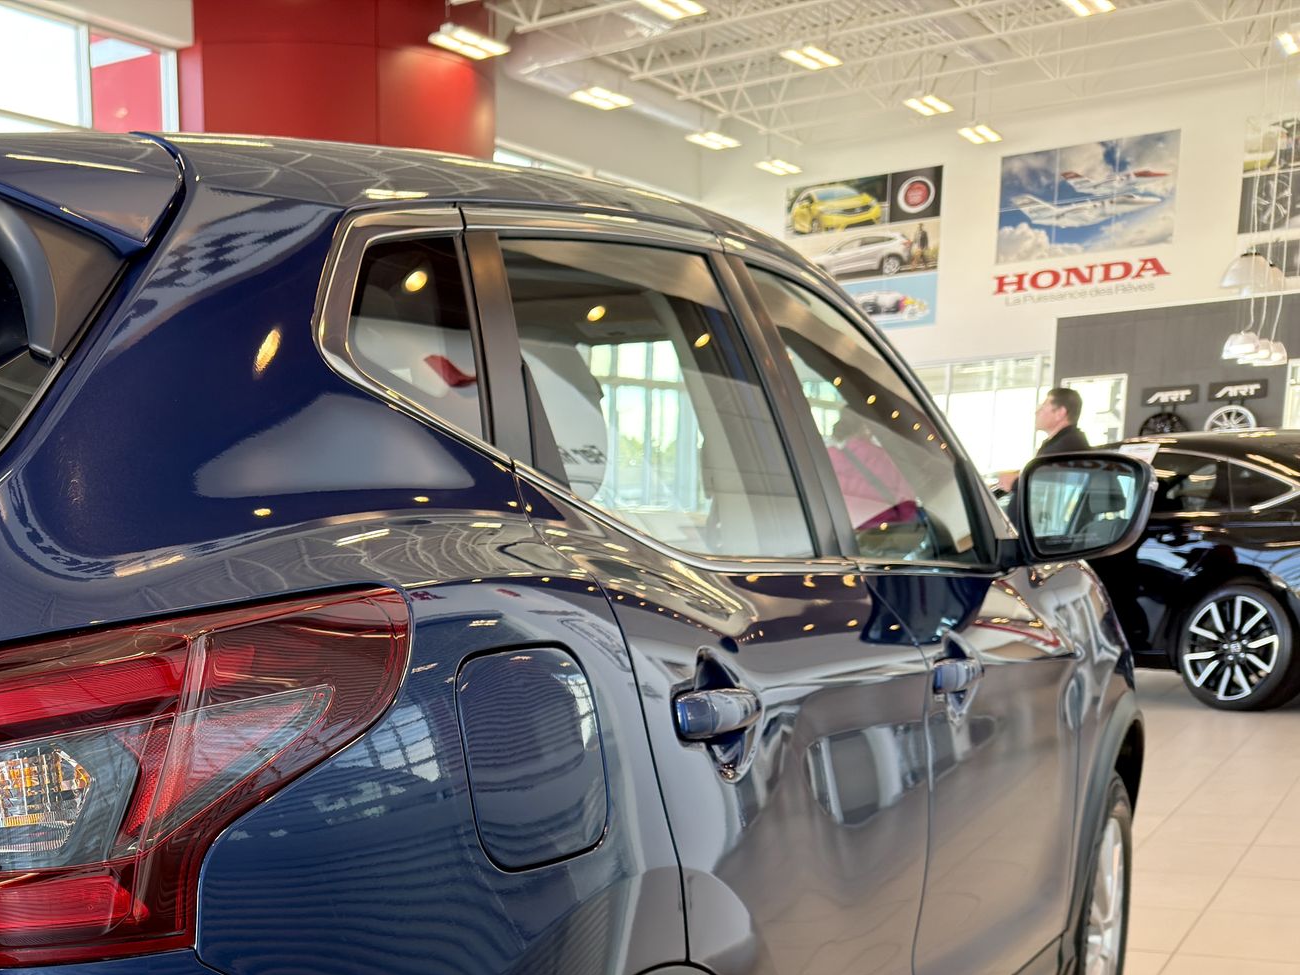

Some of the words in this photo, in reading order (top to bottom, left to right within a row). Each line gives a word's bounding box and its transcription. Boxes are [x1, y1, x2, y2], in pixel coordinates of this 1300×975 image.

[993, 257, 1171, 295] HONDA
[1147, 388, 1192, 404] ART
[1215, 383, 1261, 399] ART
